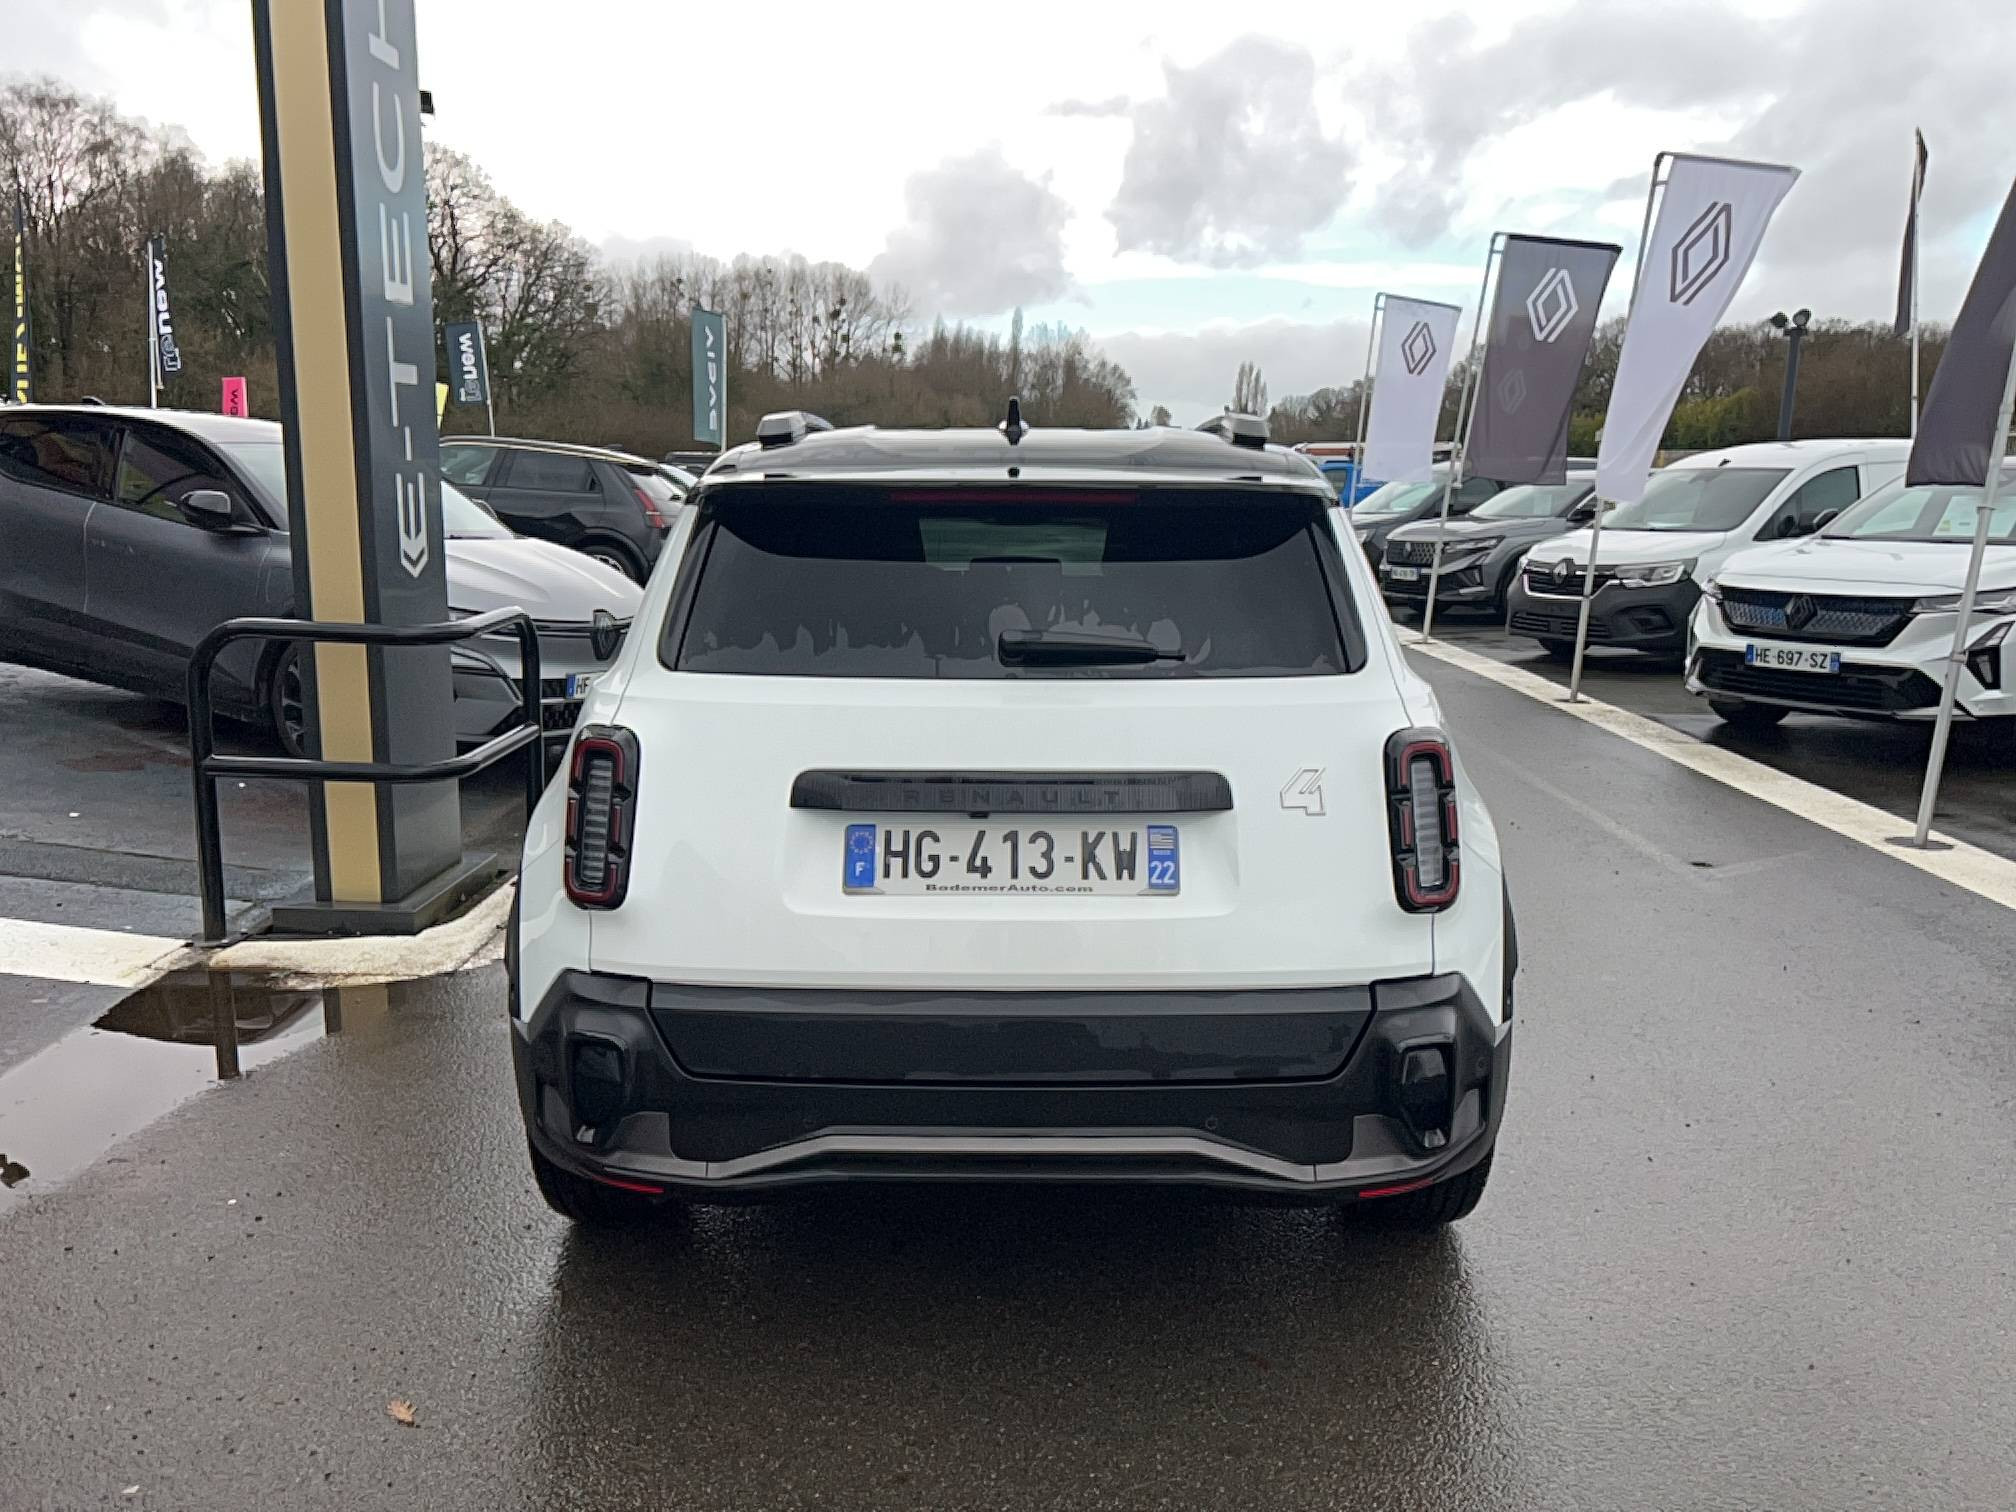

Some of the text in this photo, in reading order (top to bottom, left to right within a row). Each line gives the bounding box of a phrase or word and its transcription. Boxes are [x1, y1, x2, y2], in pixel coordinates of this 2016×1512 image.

[902, 789, 1121, 806] RENAULT
[1280, 767, 1327, 816] 4
[882, 829, 1138, 881] HG-413-KW
[855, 861, 865, 877] F
[1150, 860, 1176, 884] 22
[925, 883, 1094, 893] BodemerAuto.com
